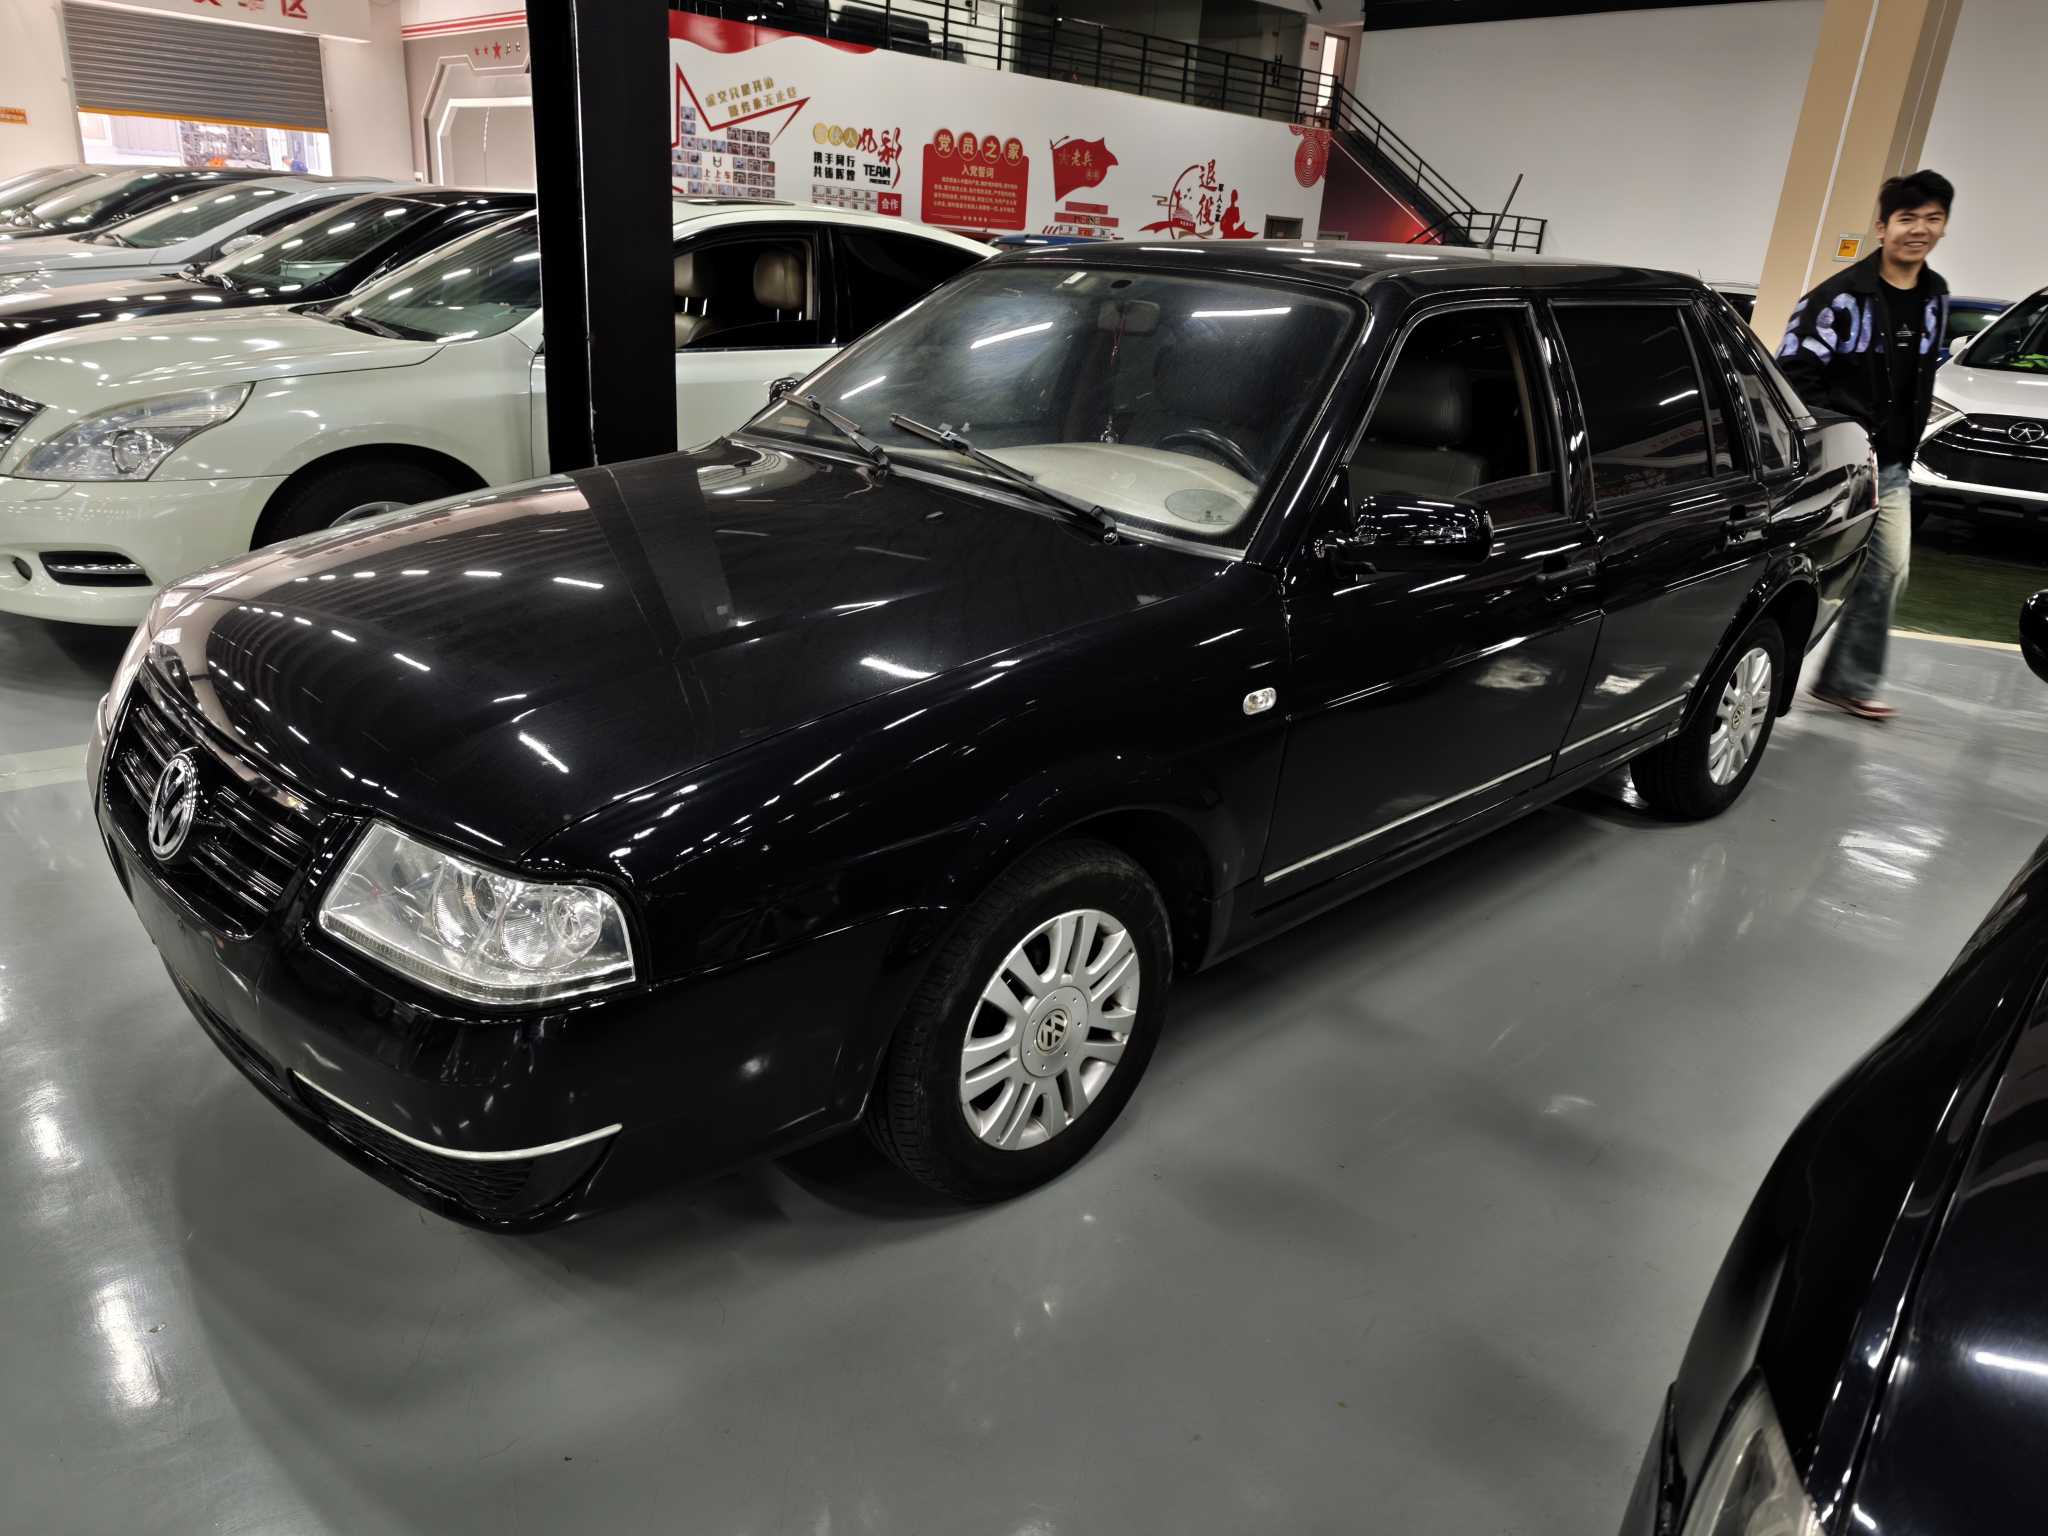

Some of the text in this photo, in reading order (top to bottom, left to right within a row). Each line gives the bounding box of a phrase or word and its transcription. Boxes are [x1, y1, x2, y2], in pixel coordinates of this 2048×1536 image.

[937, 134, 1020, 160] 党员之家
[863, 163, 891, 178] TEAM
[1196, 159, 1217, 226] 退役
[881, 198, 899, 211] 合作
